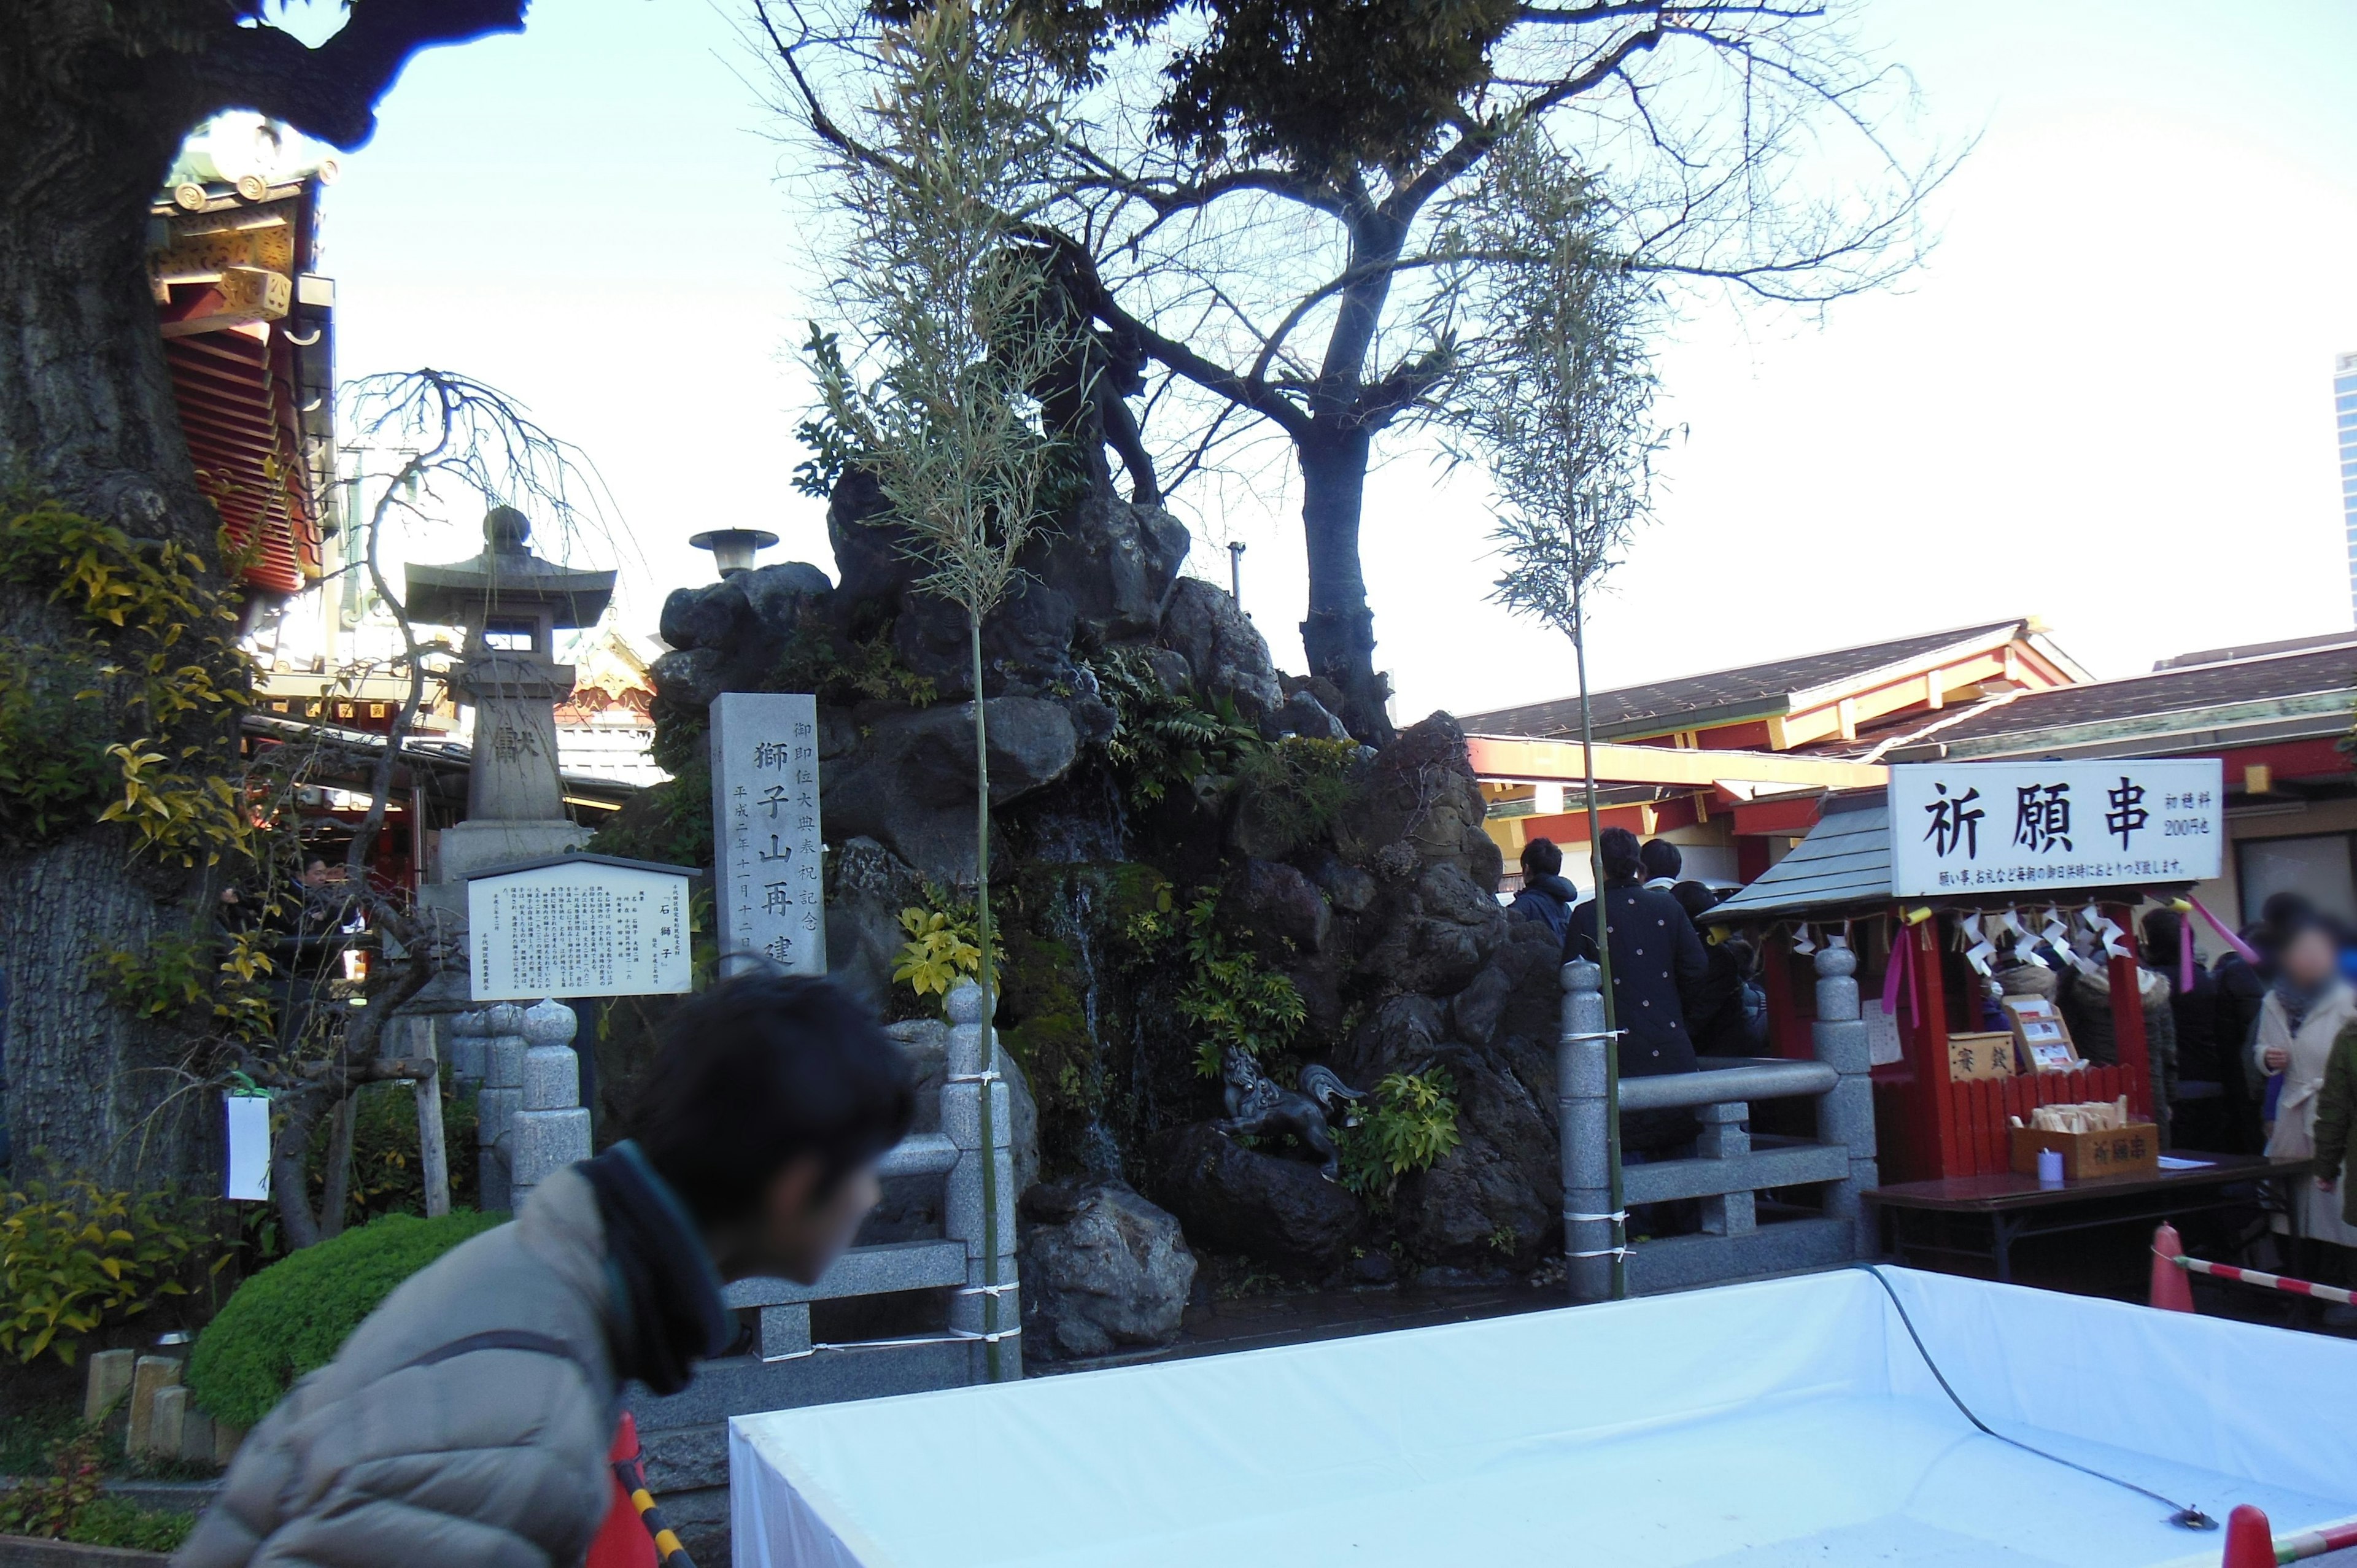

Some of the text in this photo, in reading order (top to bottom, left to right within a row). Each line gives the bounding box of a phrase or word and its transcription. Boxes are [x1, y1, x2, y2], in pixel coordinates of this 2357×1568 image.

[754, 741, 795, 968] 獅子山再建
[794, 722, 818, 931] 御即位大典奉祝記念
[1923, 776, 2150, 860] 祈願串
[2164, 817, 2210, 836] 200円也
[2165, 791, 2211, 810] 初穂料
[732, 786, 753, 949] 平成二年十一月十二日
